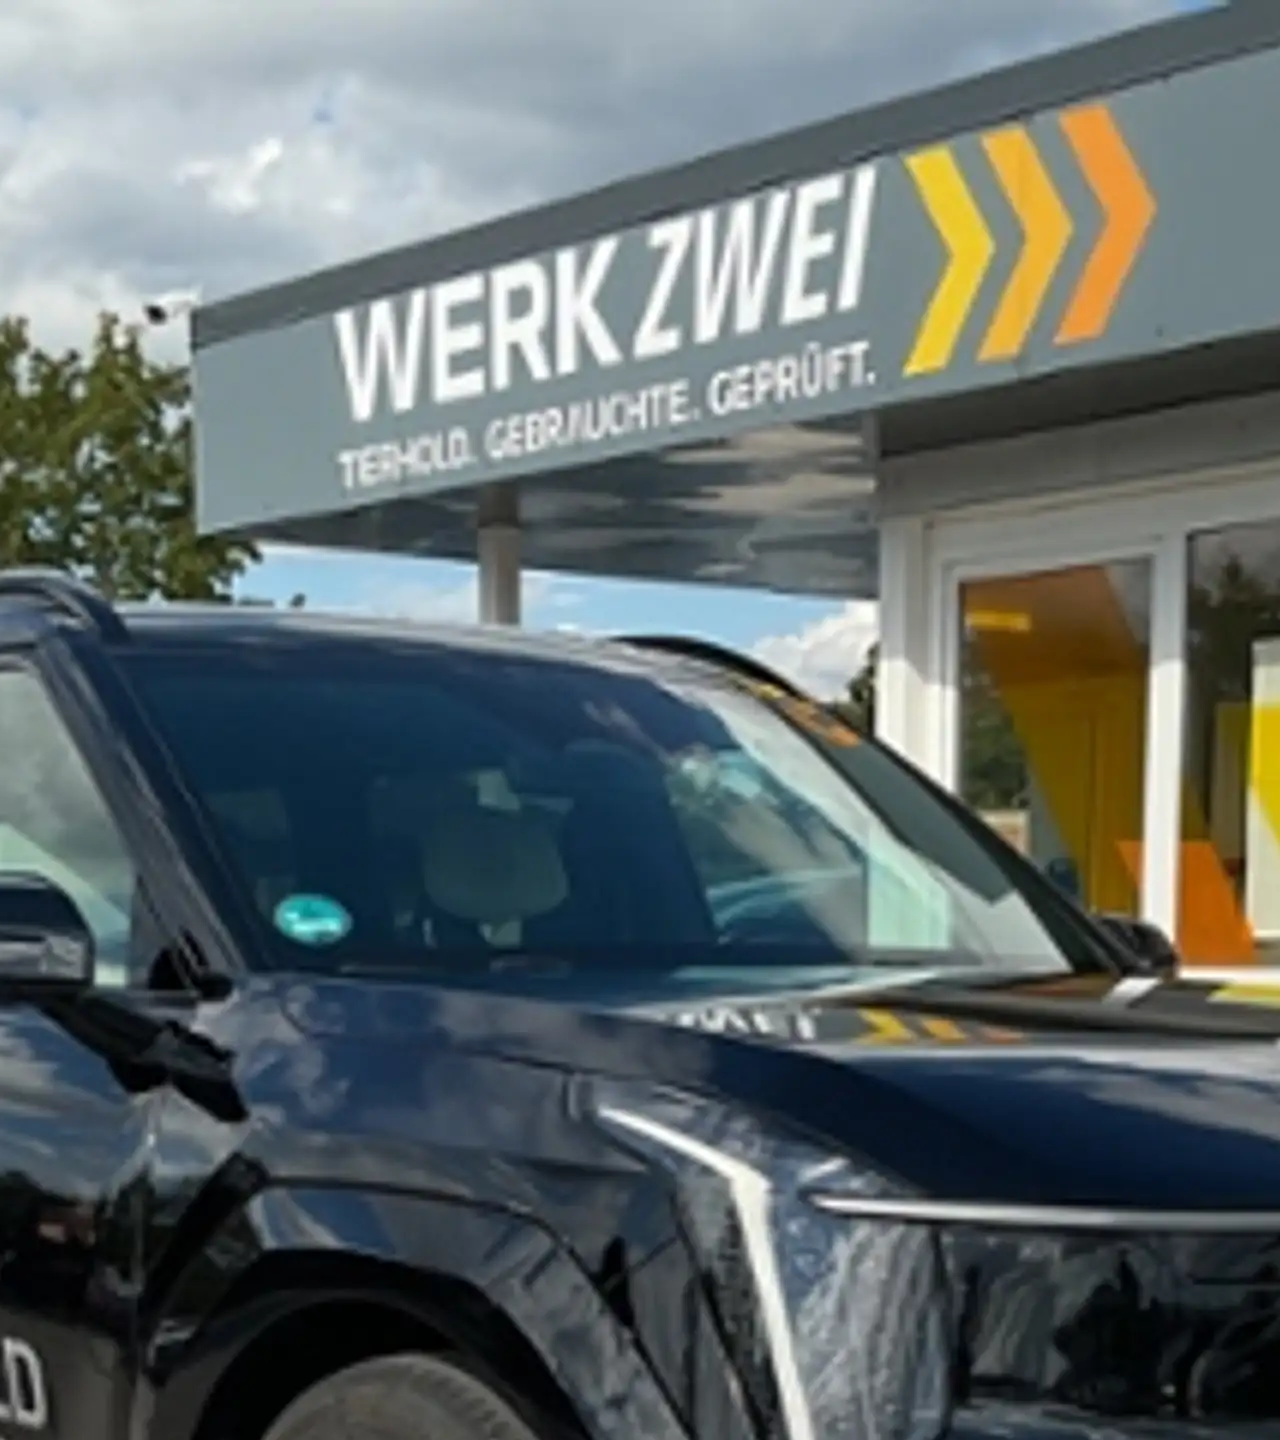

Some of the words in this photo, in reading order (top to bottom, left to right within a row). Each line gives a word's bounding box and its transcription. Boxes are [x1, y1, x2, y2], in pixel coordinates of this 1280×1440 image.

[334, 235, 622, 422] WERK
[633, 165, 876, 360] ZWEI
[707, 340, 877, 416] GEPRÜFT.
